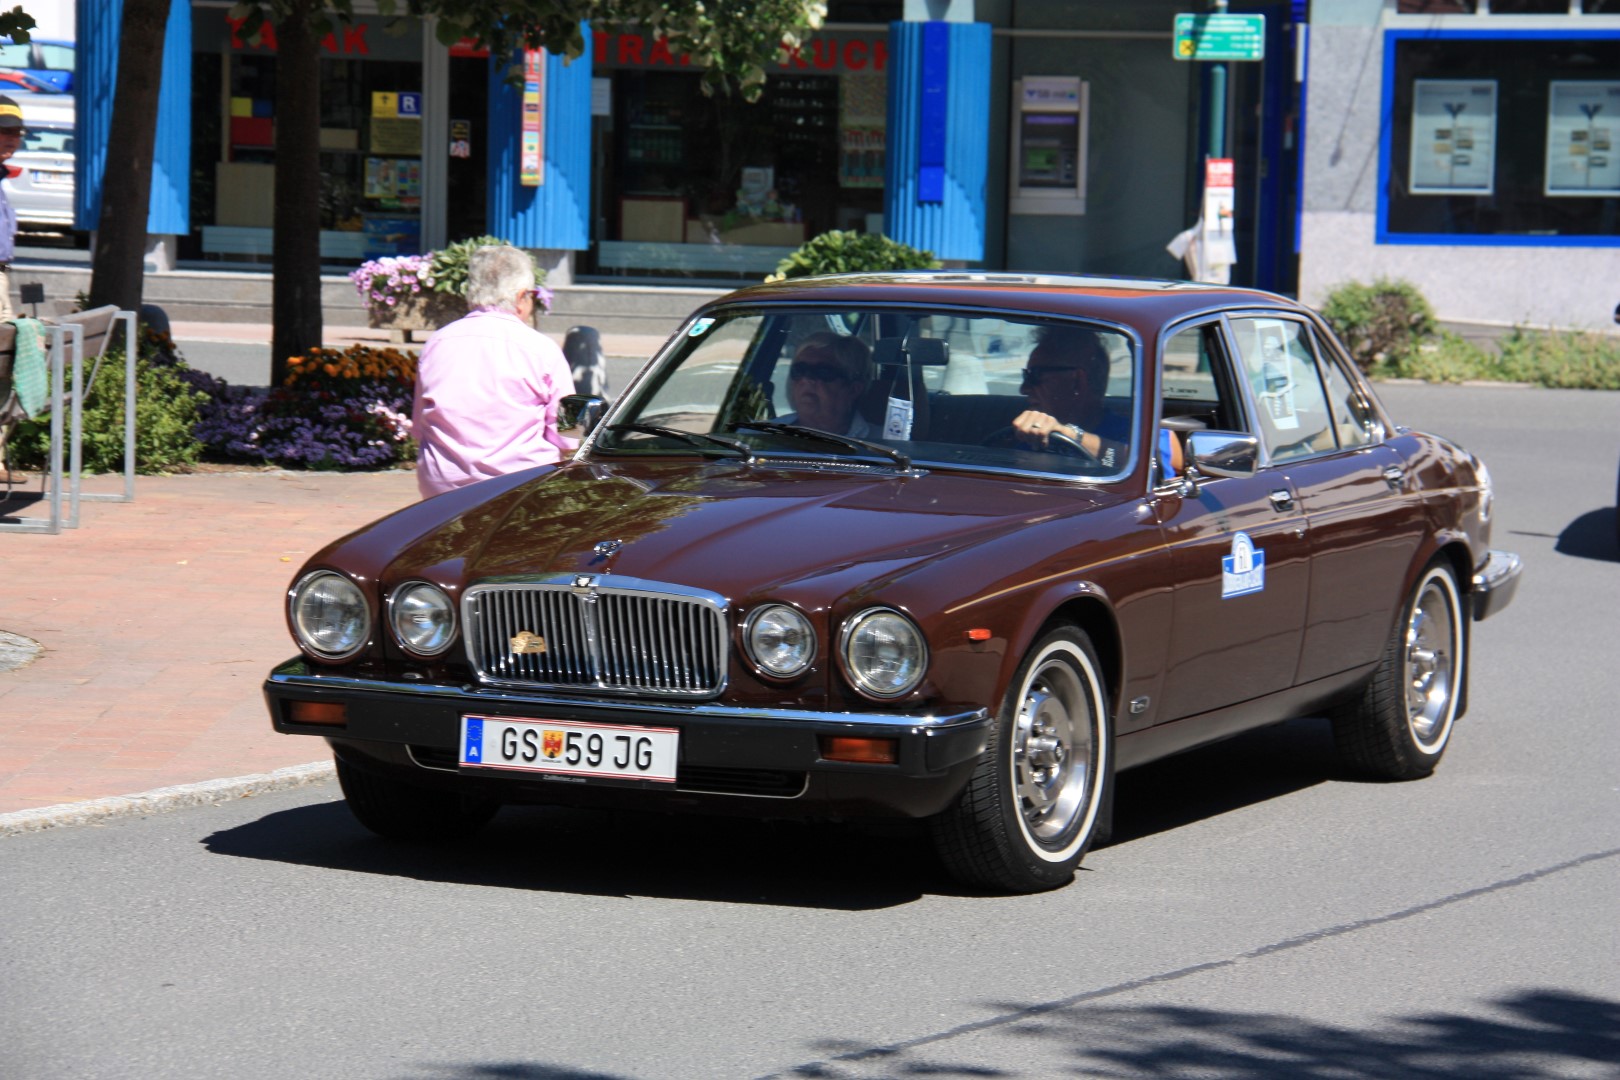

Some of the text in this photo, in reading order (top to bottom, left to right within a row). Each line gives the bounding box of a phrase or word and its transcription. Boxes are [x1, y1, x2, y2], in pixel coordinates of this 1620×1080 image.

[224, 16, 369, 55] TAAK
[402, 95, 417, 112] R
[468, 745, 479, 757] A
[501, 727, 652, 771] GS 59 JG
